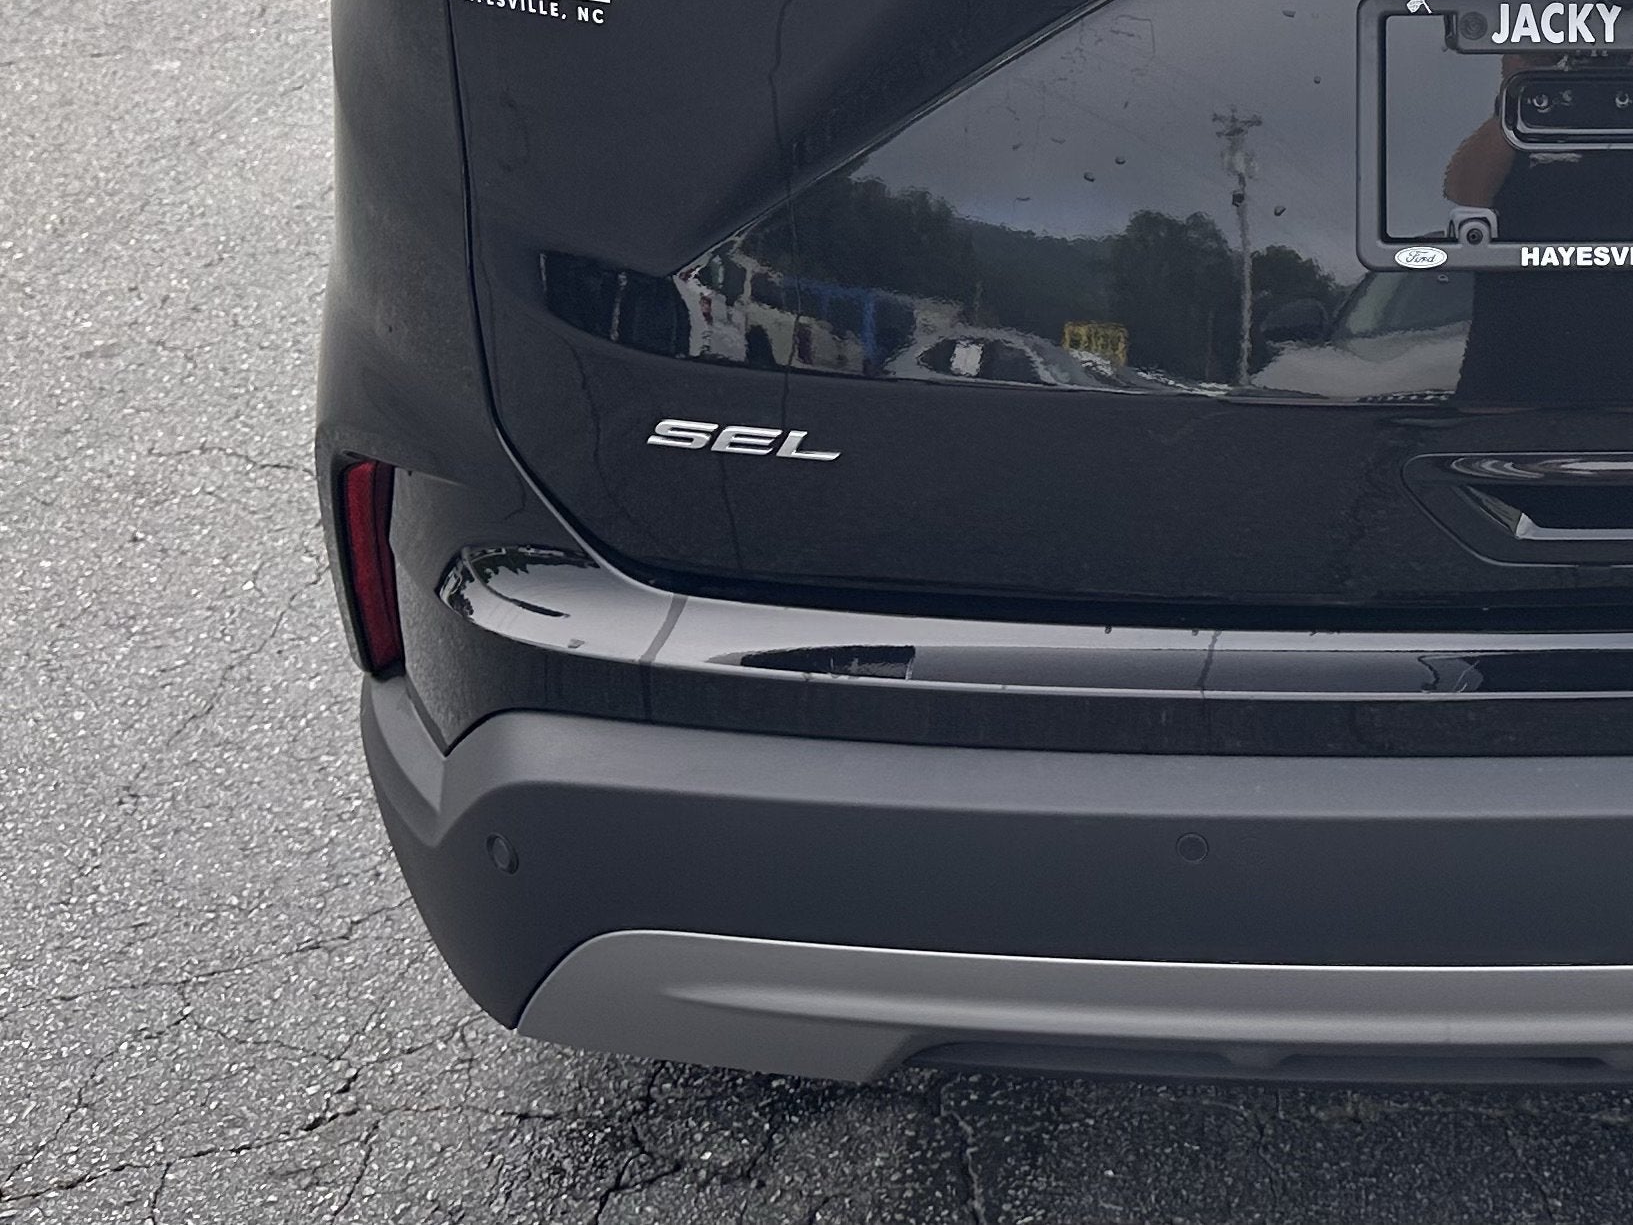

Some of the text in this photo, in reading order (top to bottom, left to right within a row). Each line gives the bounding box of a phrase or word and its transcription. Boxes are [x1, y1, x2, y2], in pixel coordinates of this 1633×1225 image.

[577, 6, 604, 24] NC
[1491, 3, 1622, 45] JACKY
[646, 418, 842, 462] SEL
